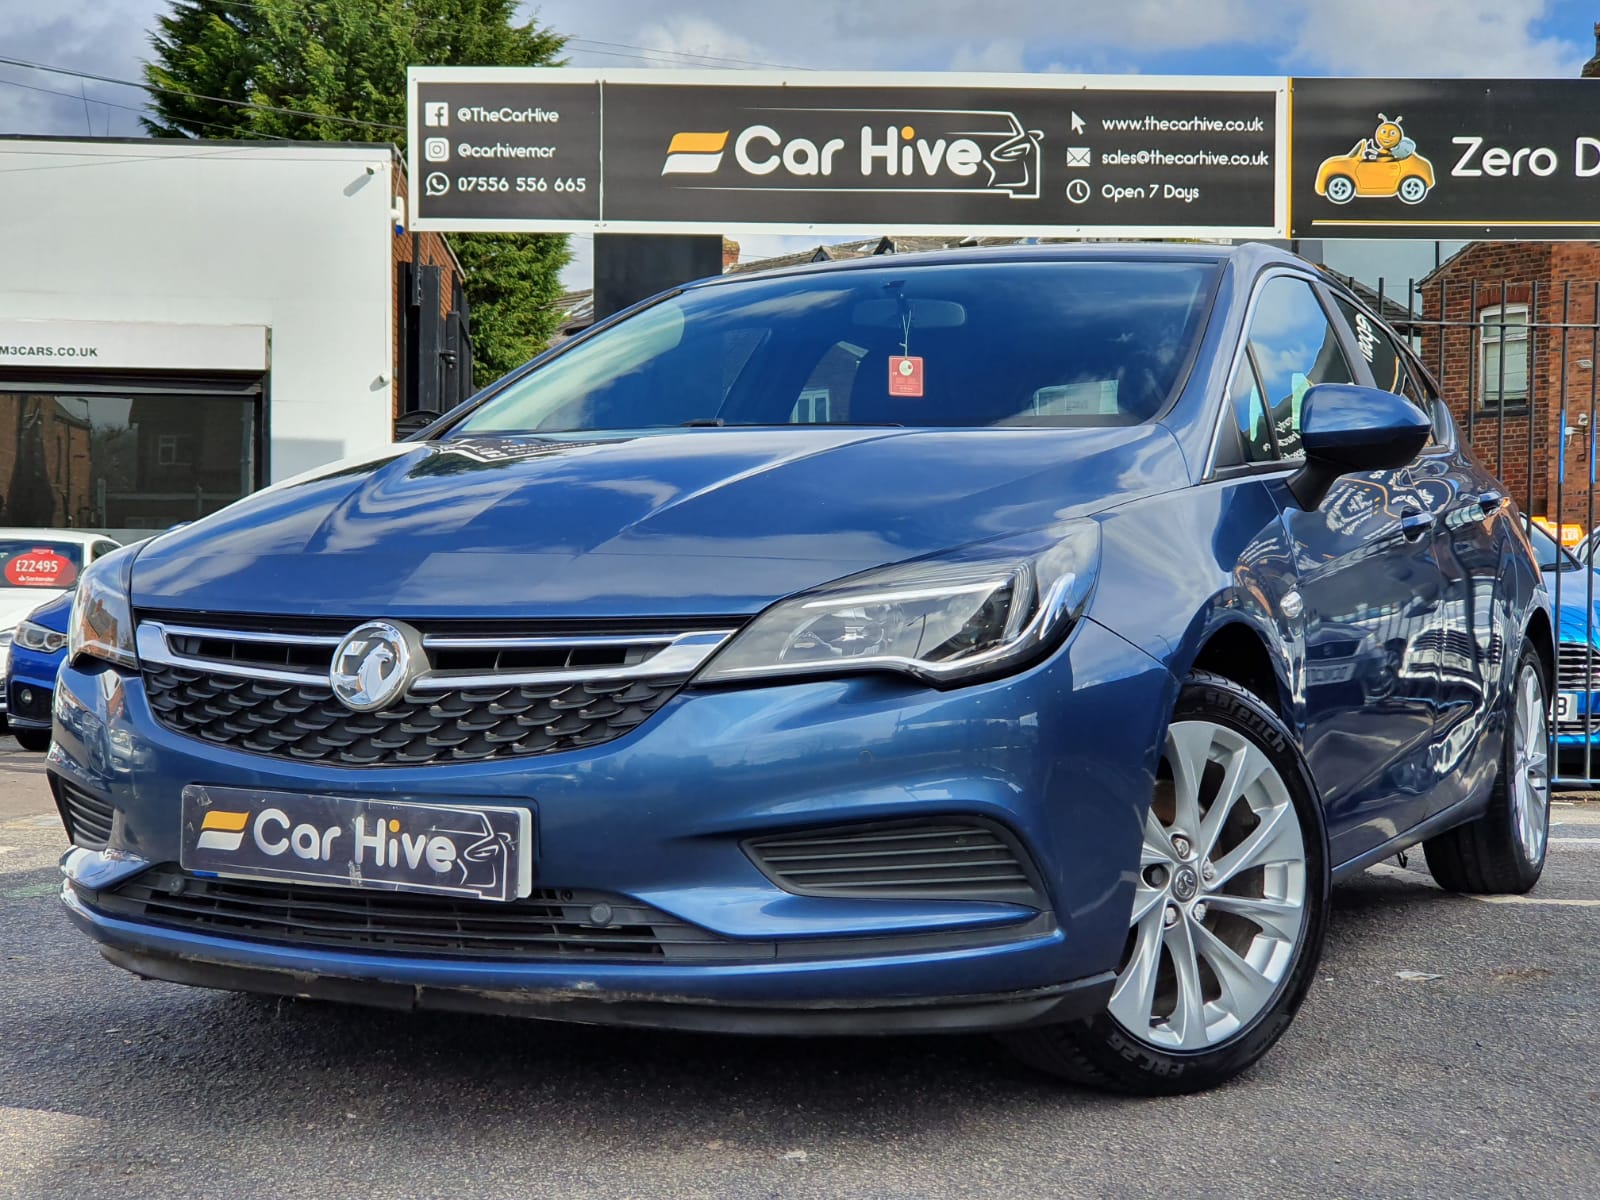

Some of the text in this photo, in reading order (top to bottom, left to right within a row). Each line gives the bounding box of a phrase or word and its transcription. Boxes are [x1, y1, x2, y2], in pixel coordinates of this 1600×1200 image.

[457, 106, 560, 123] @TheCarHive
[1101, 115, 1265, 132] www.thecarhive.co.uk
[457, 142, 557, 158] @carhivemcr
[734, 125, 983, 176] Car Hive
[1101, 149, 1270, 166] sales@thecarhive.co.uk
[1450, 136, 1558, 177] Zero
[457, 176, 587, 192] 07556 556 665
[1101, 184, 1200, 203] Open 7 Days
[15, 559, 59, 573] £22495
[253, 808, 457, 873] Car Hive
